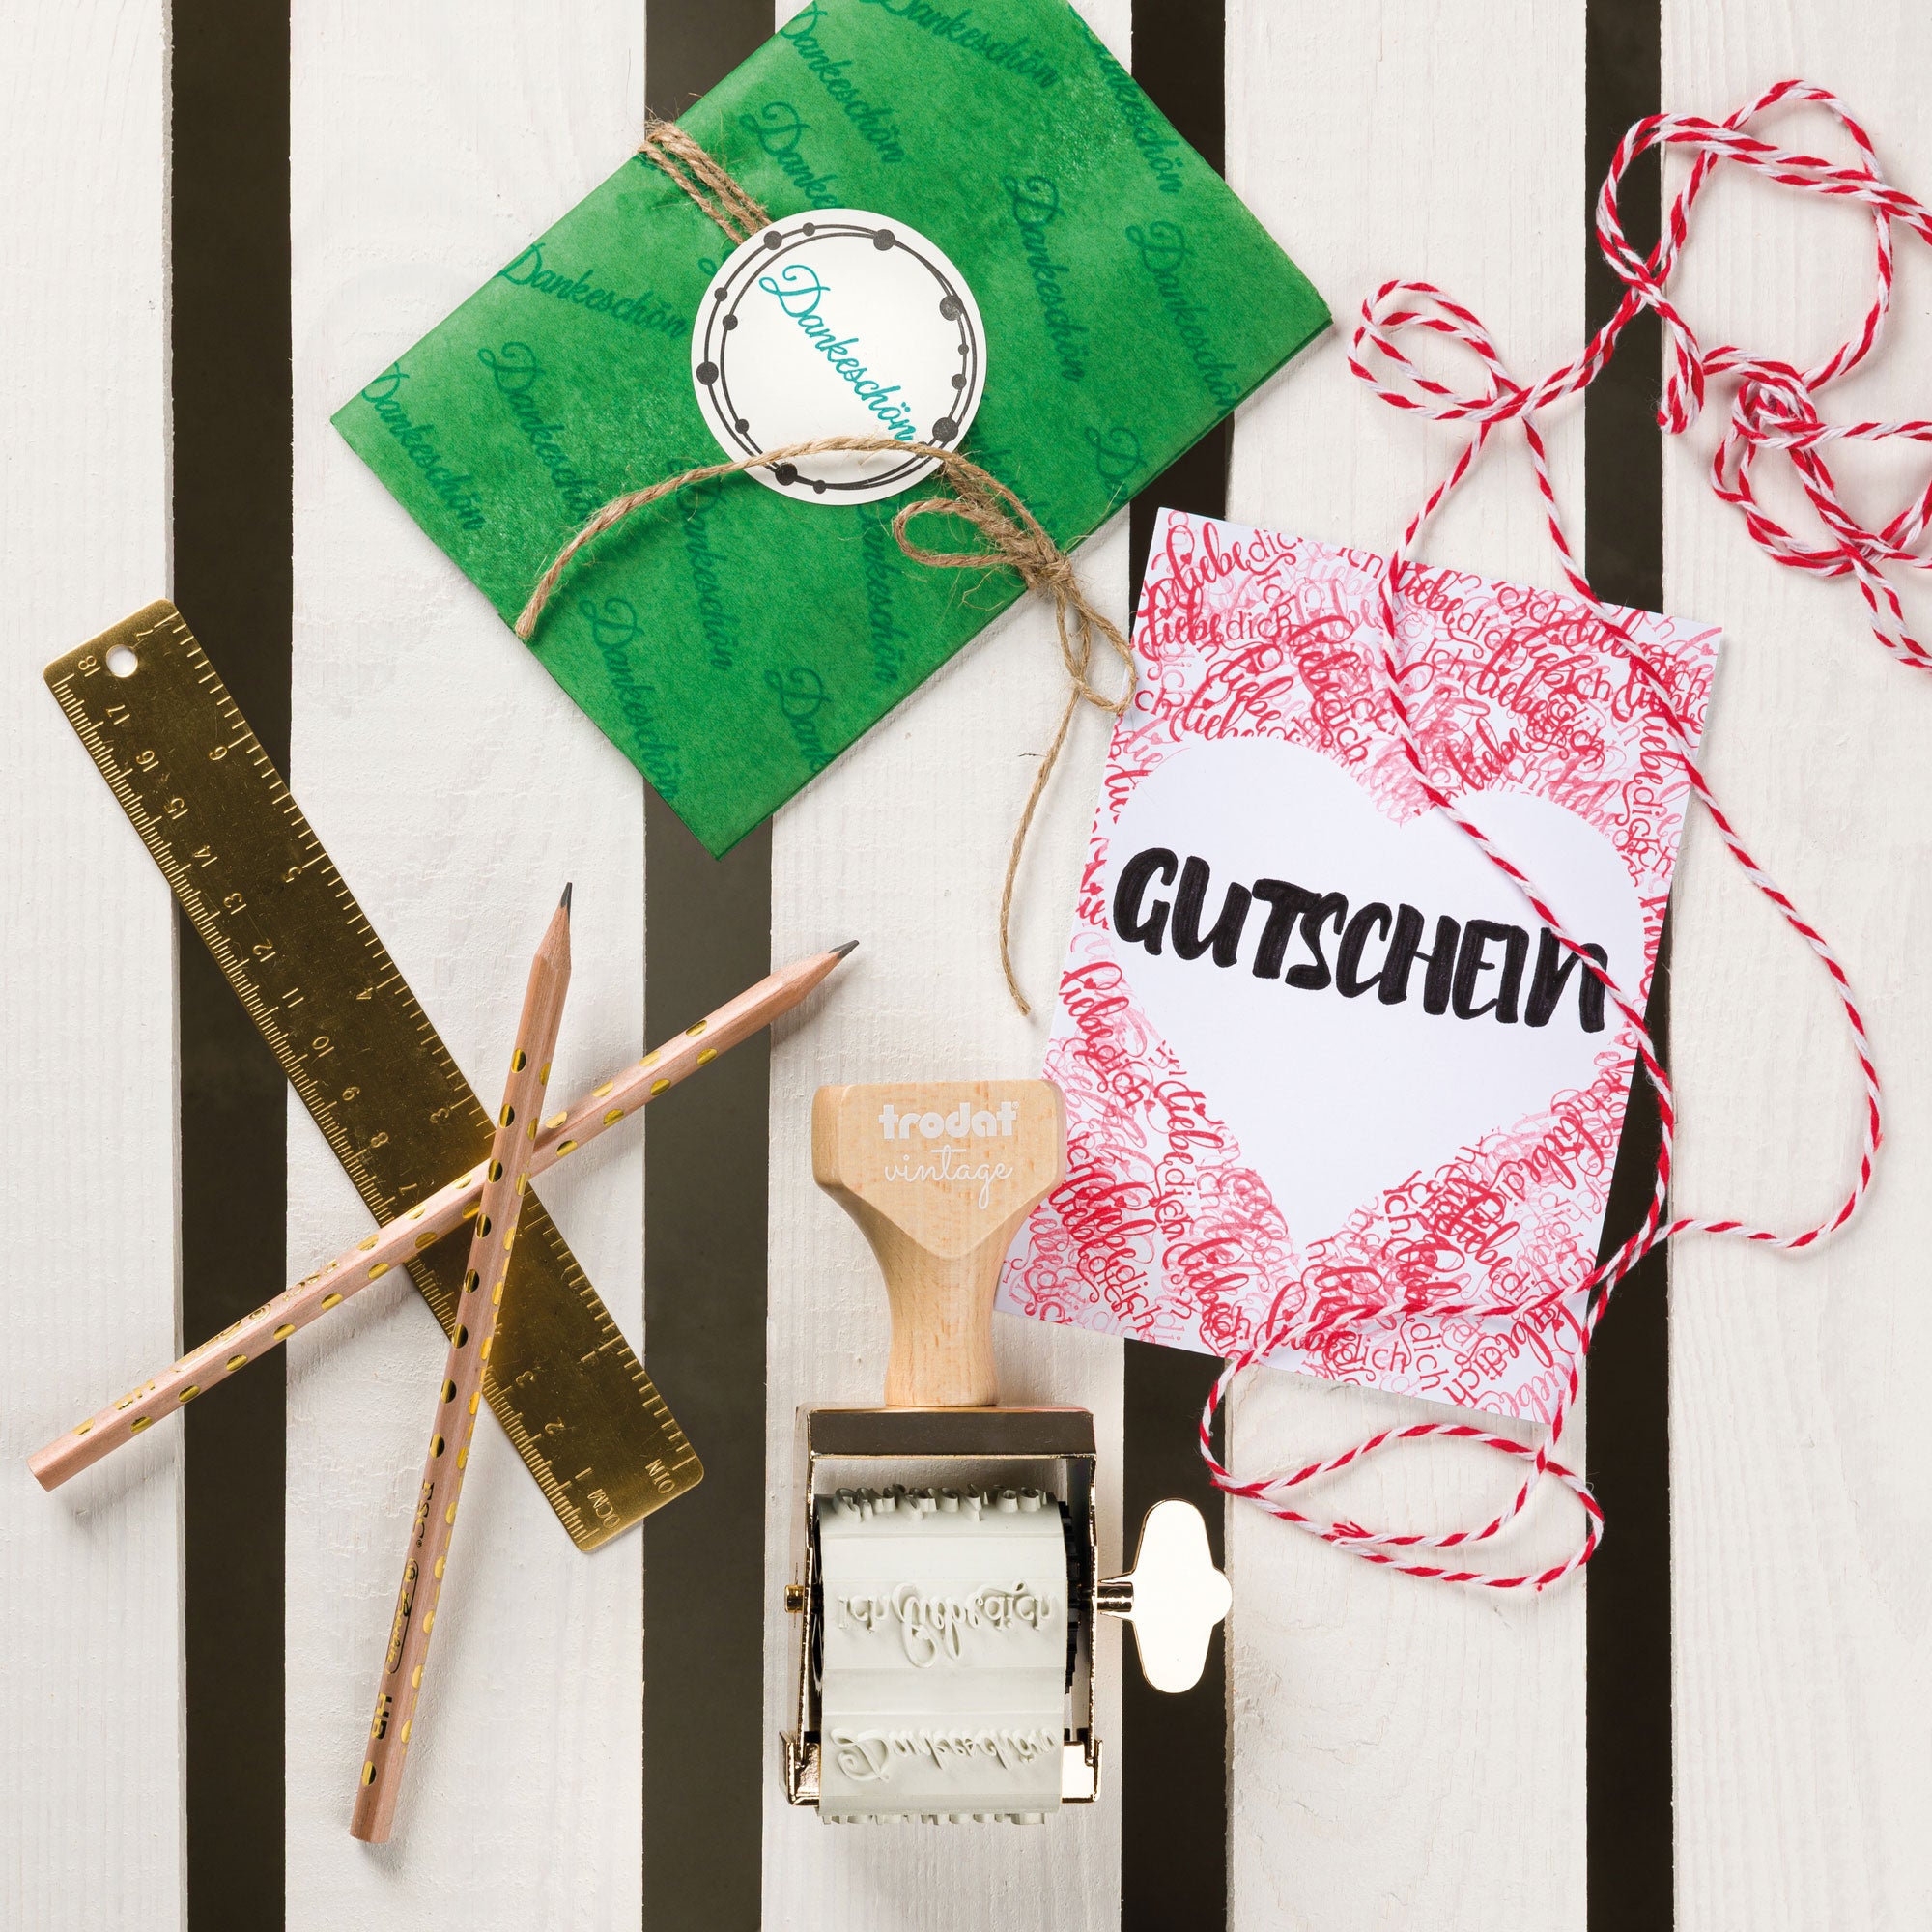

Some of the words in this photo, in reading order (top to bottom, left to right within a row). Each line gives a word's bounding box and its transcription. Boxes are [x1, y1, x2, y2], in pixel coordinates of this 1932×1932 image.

[739, 101, 845, 209] Danke
[758, 264, 917, 441] Dankeschön
[477, 341, 604, 523] Dankeschö
[134, 628, 155, 641] 7
[77, 655, 101, 677] 18
[105, 704, 131, 725] 17
[135, 750, 160, 773] 16
[164, 797, 189, 820] 15
[193, 844, 218, 867] 14
[223, 892, 247, 915] 13
[252, 938, 276, 962] 12
[1113, 847, 1609, 1033] GUTSCHEIN
[311, 1035, 335, 1058] 10
[341, 1085, 361, 1102] 9
[429, 1107, 450, 1123] 3
[370, 1131, 389, 1150] 8
[883, 1144, 1014, 1209] vintage
[515, 1370, 535, 1388] 3
[544, 1416, 566, 1435] 2
